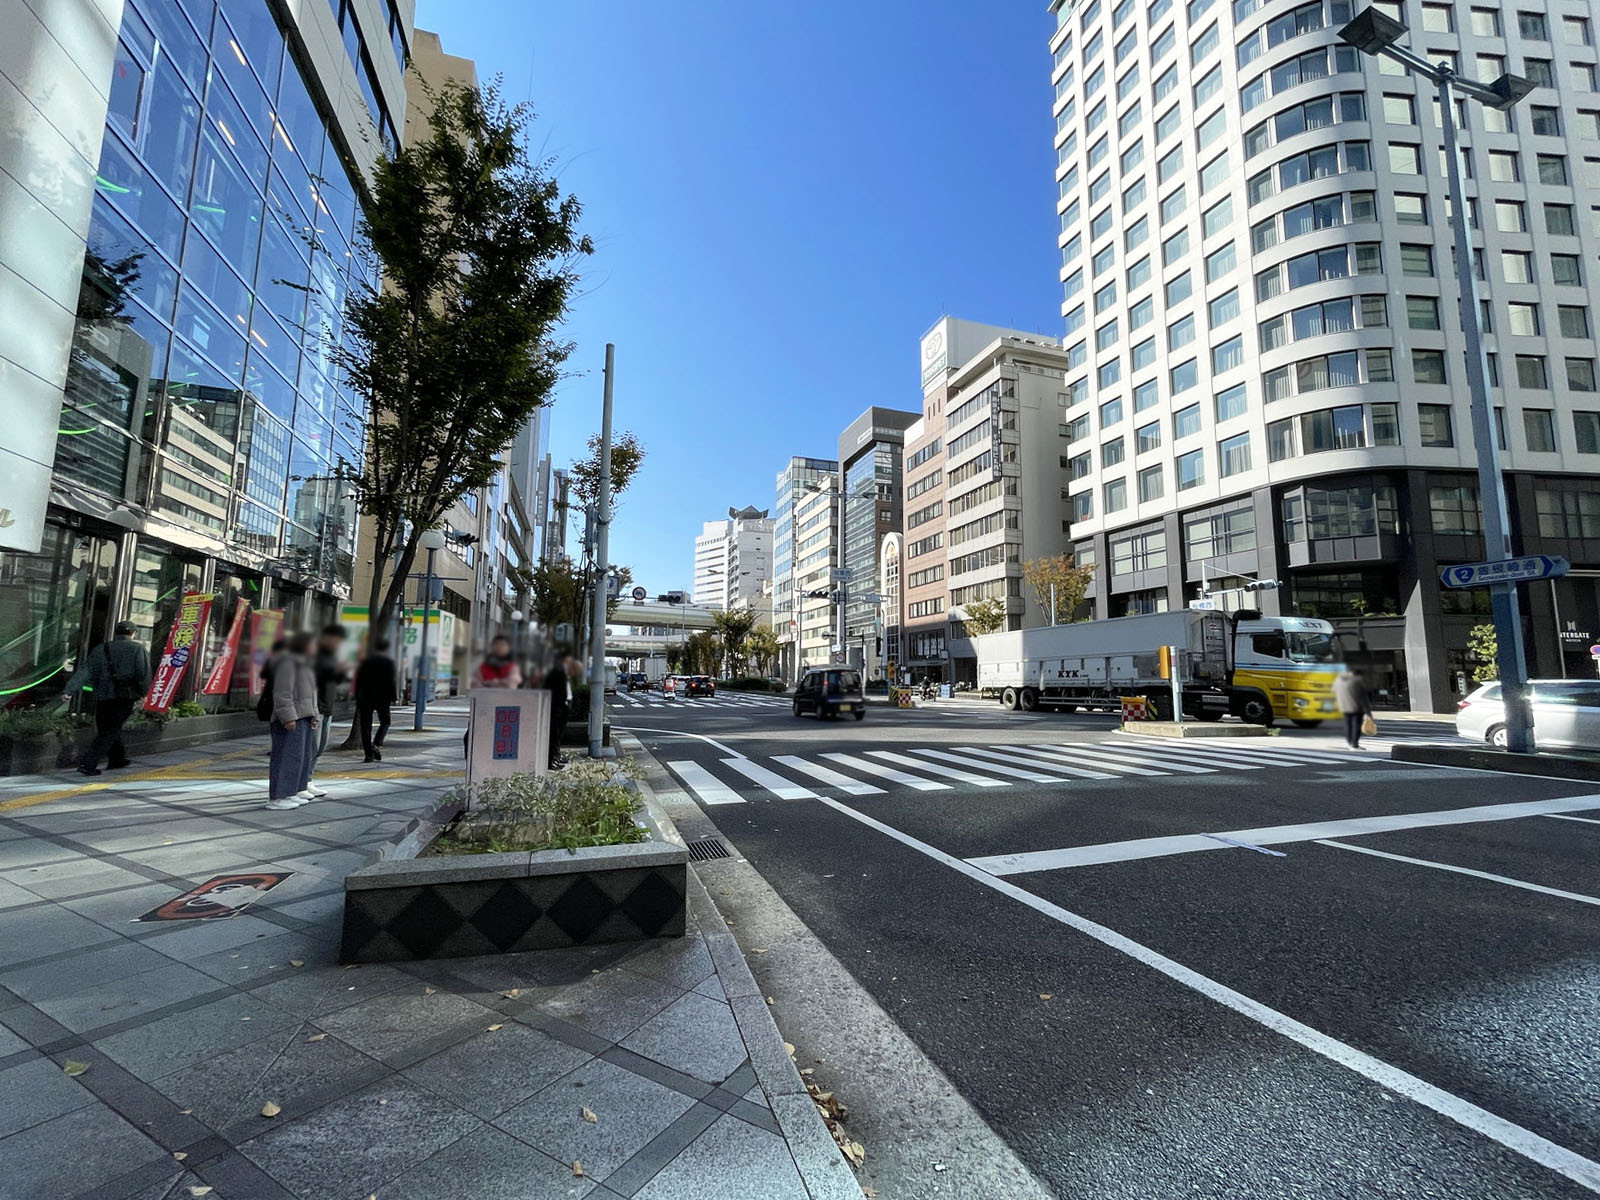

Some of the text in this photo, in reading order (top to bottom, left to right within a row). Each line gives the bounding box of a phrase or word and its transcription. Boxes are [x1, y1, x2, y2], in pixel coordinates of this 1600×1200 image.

[1460, 570, 1469, 579] 2
[173, 605, 199, 649] 車検
[1058, 670, 1080, 678] KYK
